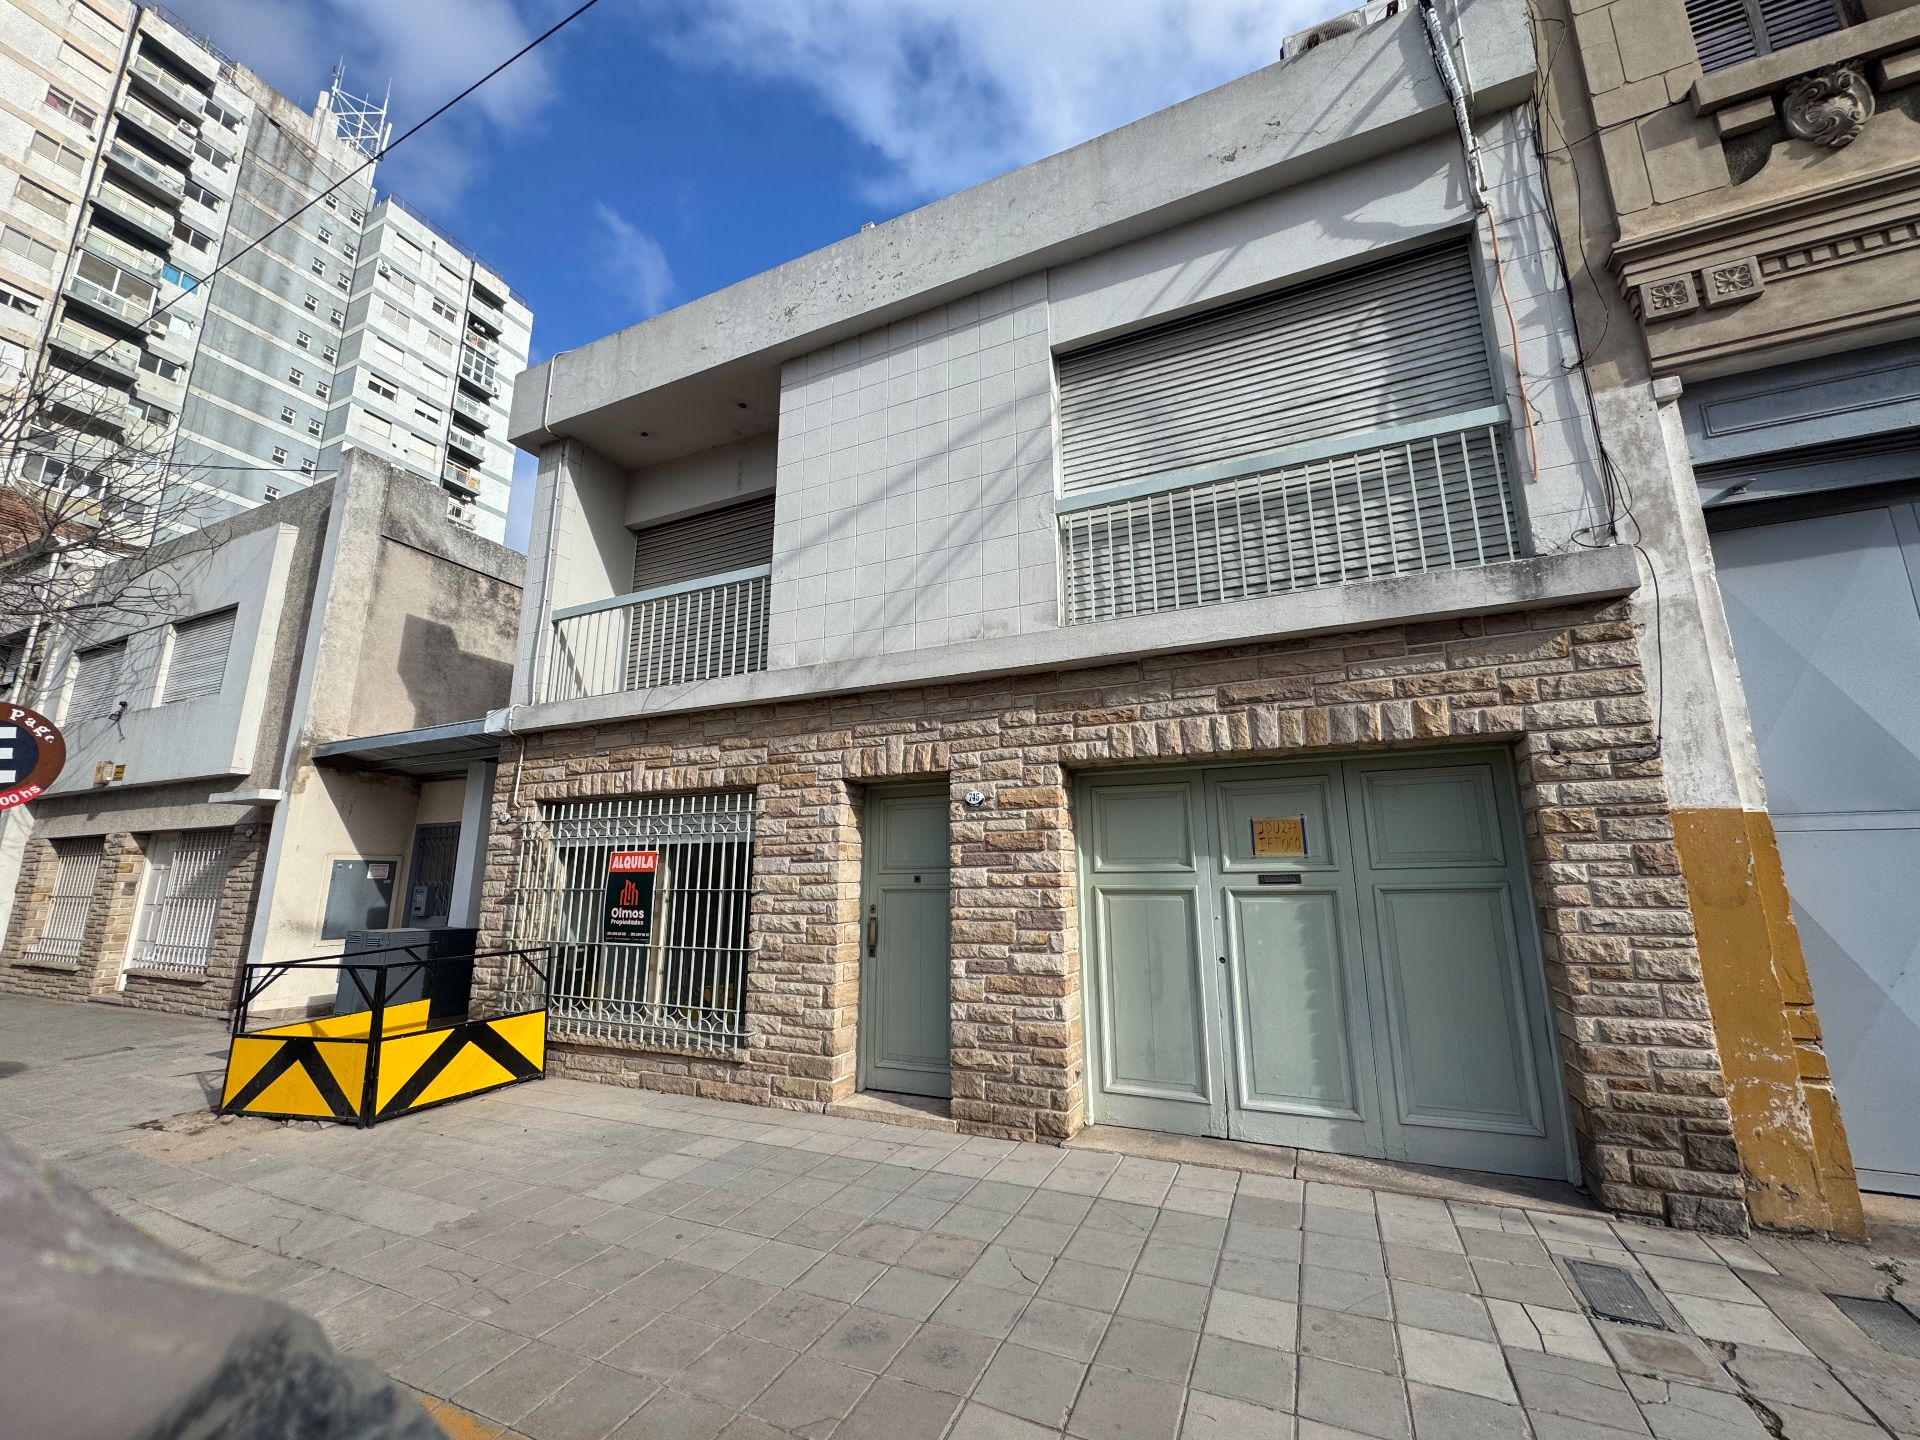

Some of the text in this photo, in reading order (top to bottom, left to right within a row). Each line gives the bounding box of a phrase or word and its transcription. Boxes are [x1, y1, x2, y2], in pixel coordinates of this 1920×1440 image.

[19, 784, 41, 799] hs
[611, 855, 654, 870] ALQUILA
[611, 907, 645, 919] Olmos
[610, 918, 644, 926] Propiedades
